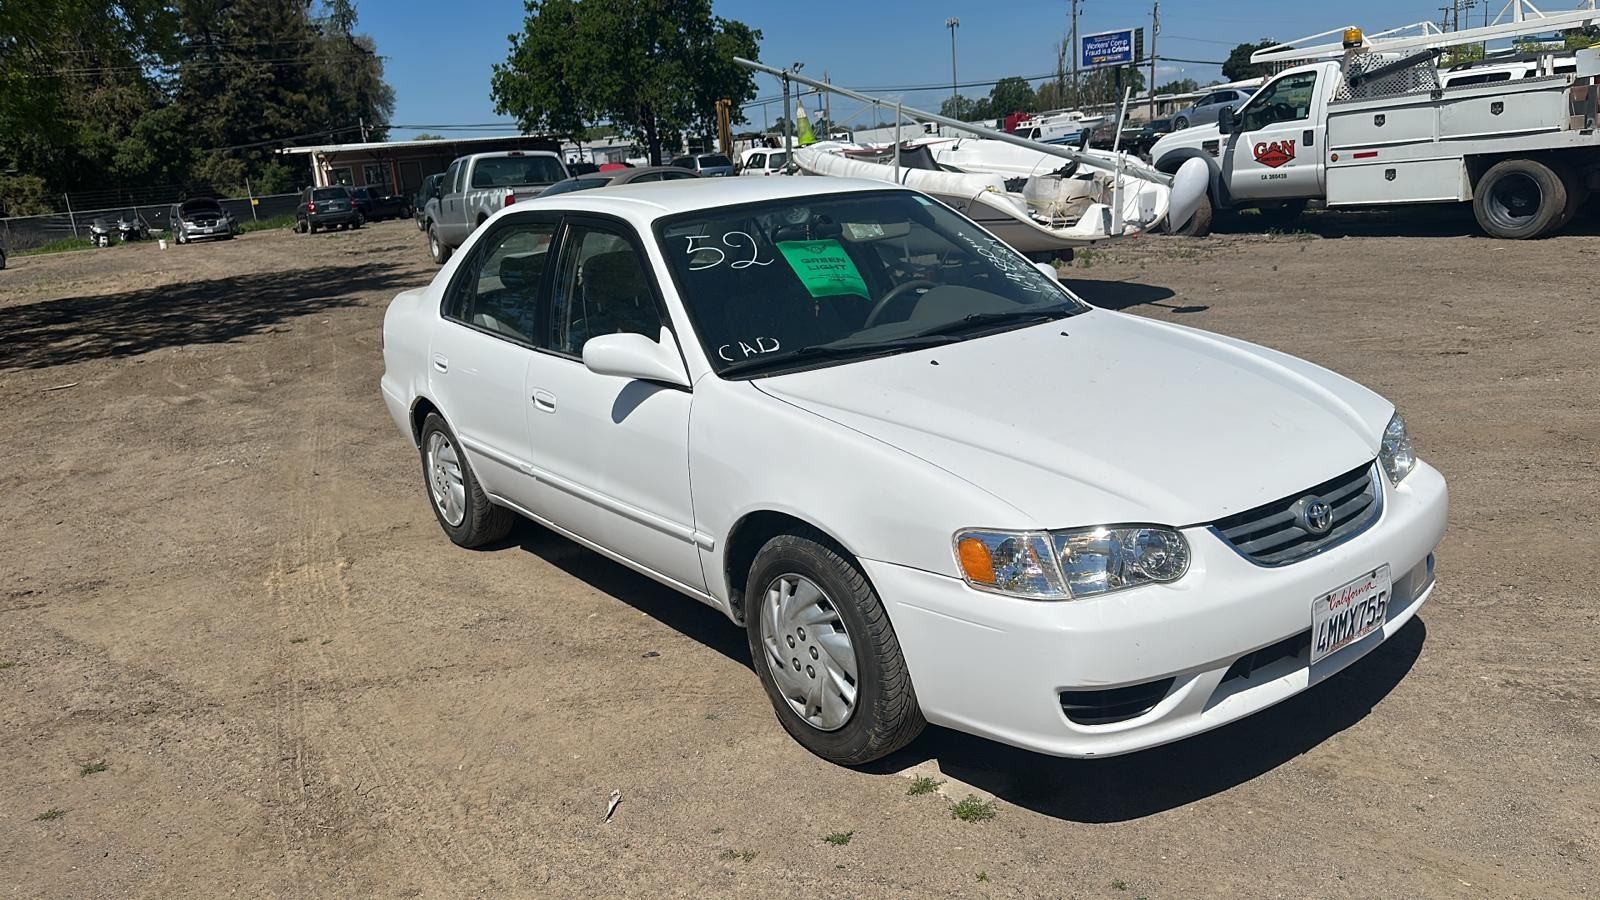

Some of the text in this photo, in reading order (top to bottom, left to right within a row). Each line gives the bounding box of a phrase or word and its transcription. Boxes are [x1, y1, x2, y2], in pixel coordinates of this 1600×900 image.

[1085, 48, 1101, 57] Fraud
[1111, 45, 1130, 53] Crime
[1086, 39, 1128, 50] Workers' Comp
[1253, 139, 1296, 160] G&N
[685, 231, 775, 271] 52
[800, 256, 846, 264] GREEN
[718, 336, 780, 361] CAD
[1329, 581, 1377, 611] California
[1316, 590, 1387, 653] 4MMX755
